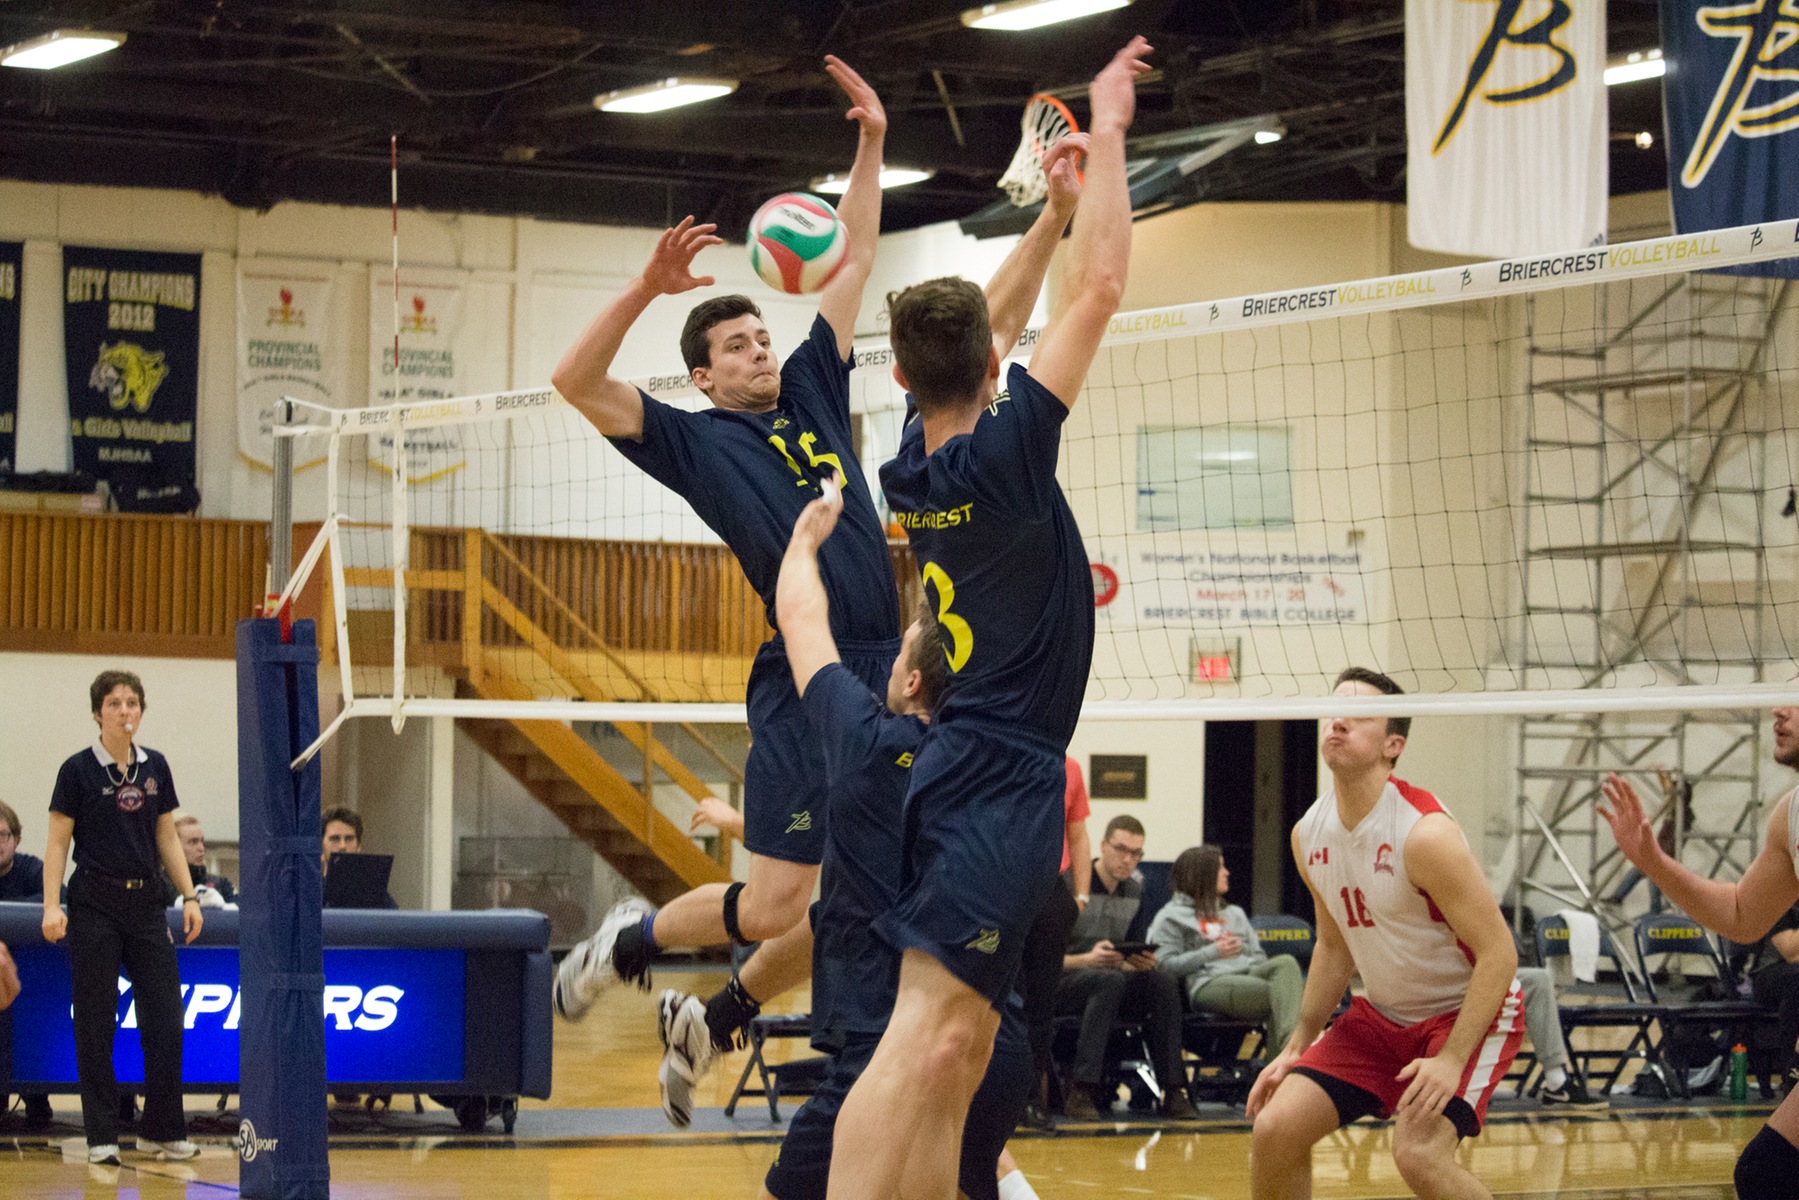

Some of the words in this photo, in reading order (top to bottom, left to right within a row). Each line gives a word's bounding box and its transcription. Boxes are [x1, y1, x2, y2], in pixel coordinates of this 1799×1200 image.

[67, 265, 107, 303] CITY
[108, 270, 195, 310] CHAMPIONS
[108, 302, 155, 332] 2012
[1108, 311, 1187, 335] OLLEYBALL
[1210, 551, 1276, 565] National
[1281, 551, 1360, 565] Basketball
[1284, 607, 1355, 620] COLLEGE
[1647, 927, 1702, 939] CLIPPERS
